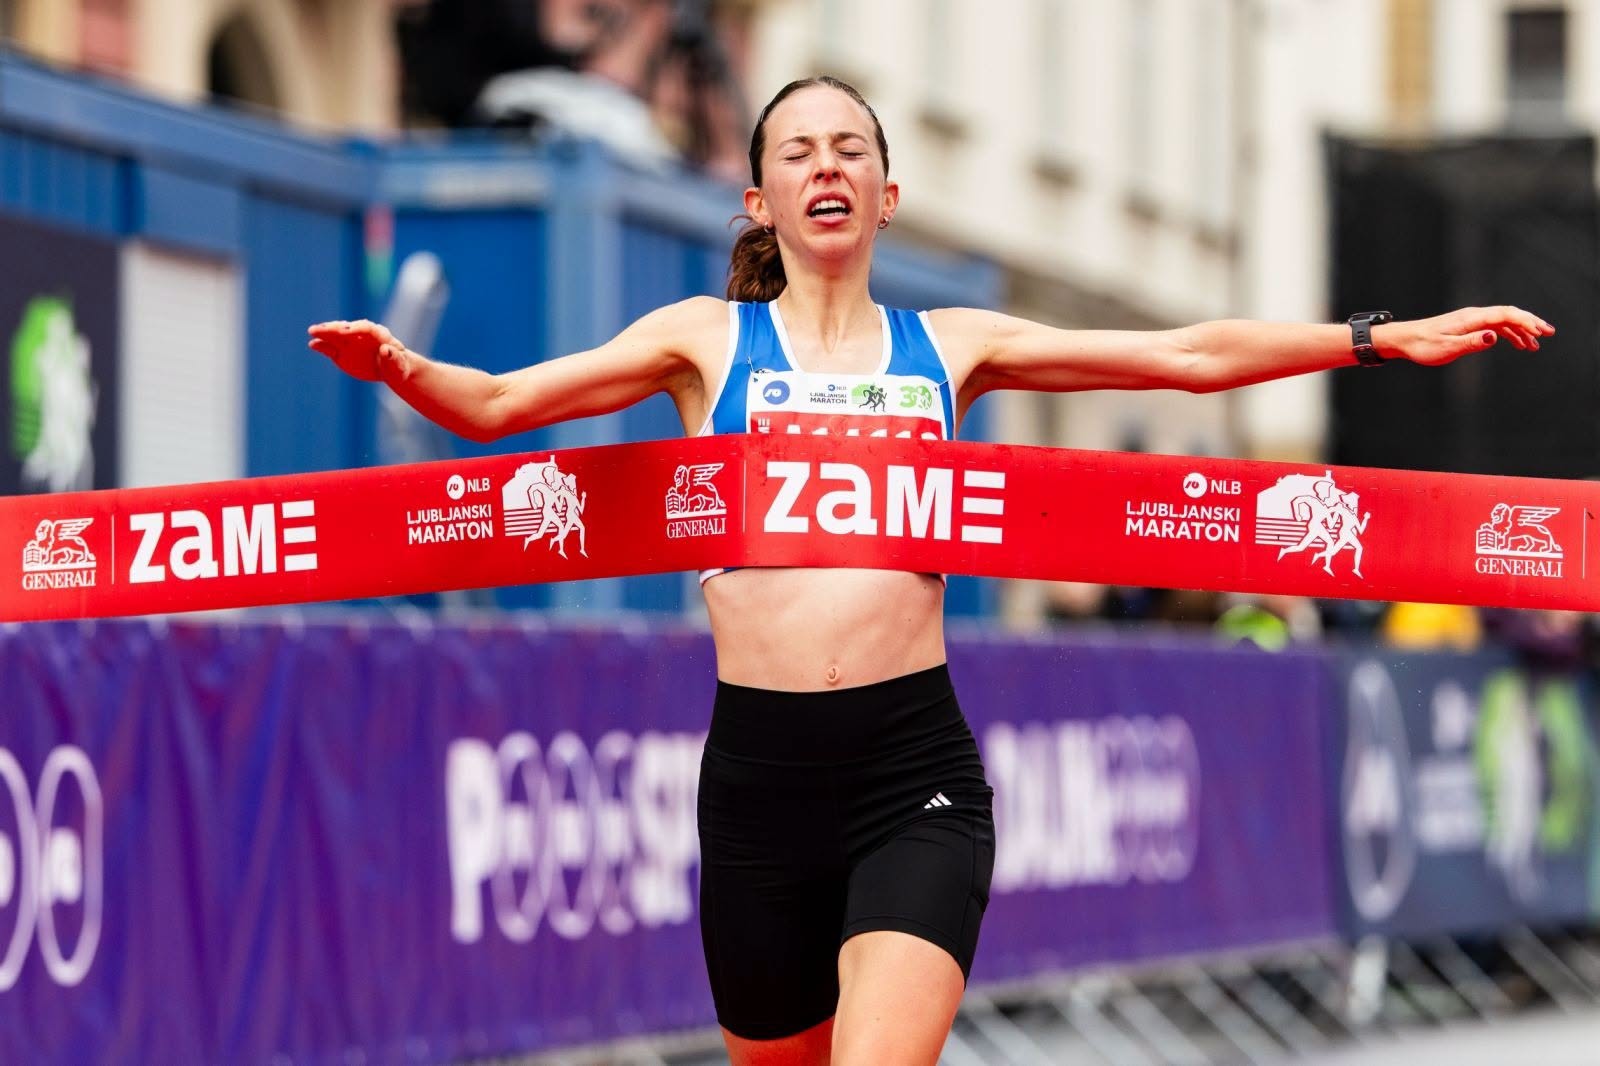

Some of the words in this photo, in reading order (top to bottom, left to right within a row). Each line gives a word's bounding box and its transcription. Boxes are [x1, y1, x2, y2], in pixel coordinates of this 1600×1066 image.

[809, 391, 847, 399] LJUBLJANSKI
[467, 477, 491, 493] NLB
[1211, 480, 1242, 495] NLB
[406, 504, 492, 525] LJUBLJANSKI
[1126, 500, 1241, 522] LJUBLJANSKI
[408, 520, 494, 545] MARATON
[666, 517, 727, 539] GENERALI
[1125, 518, 1240, 543] MARATON
[1475, 557, 1563, 578] GENERALI
[22, 570, 96, 590] GENERALI
